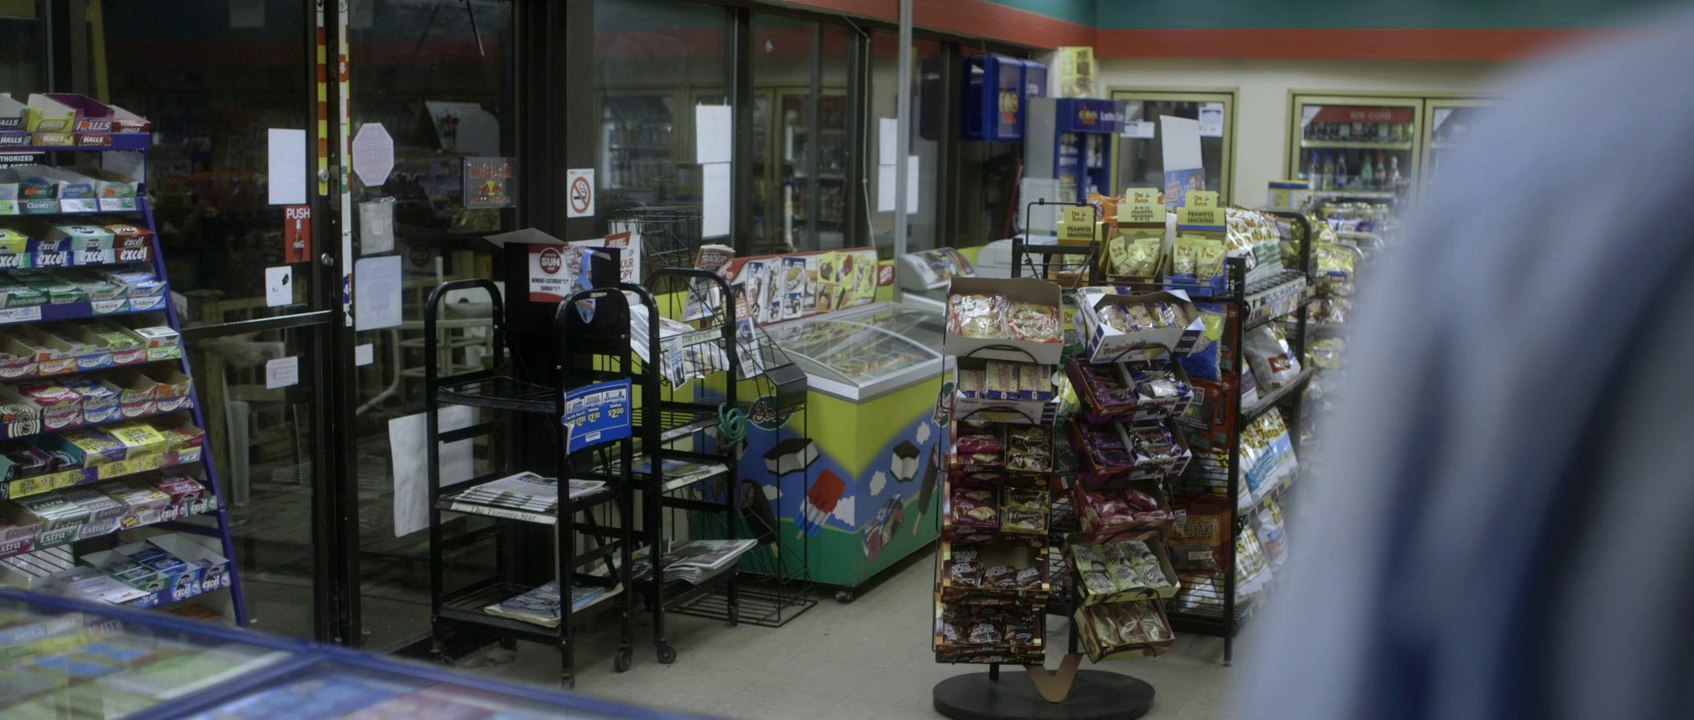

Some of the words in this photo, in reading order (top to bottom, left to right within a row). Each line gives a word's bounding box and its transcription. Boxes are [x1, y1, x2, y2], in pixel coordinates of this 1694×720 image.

[0, 119, 19, 127] ALLS
[0, 136, 23, 144] HALLS
[43, 134, 65, 142] HALLS
[286, 208, 310, 219] PUSH
[37, 251, 67, 267] excel
[119, 246, 147, 262] excel
[541, 257, 560, 267] SUN
[620, 258, 634, 268] OUR
[620, 269, 633, 280] OPY
[95, 303, 119, 312] Trident
[133, 299, 156, 309] Trident
[470, 505, 485, 514] The
[487, 508, 518, 519] Toronto
[519, 513, 537, 521] Star
[82, 524, 106, 535] Extra
[39, 532, 66, 544] Extra
[0, 542, 21, 553] xtra
[202, 575, 220, 588] excel
